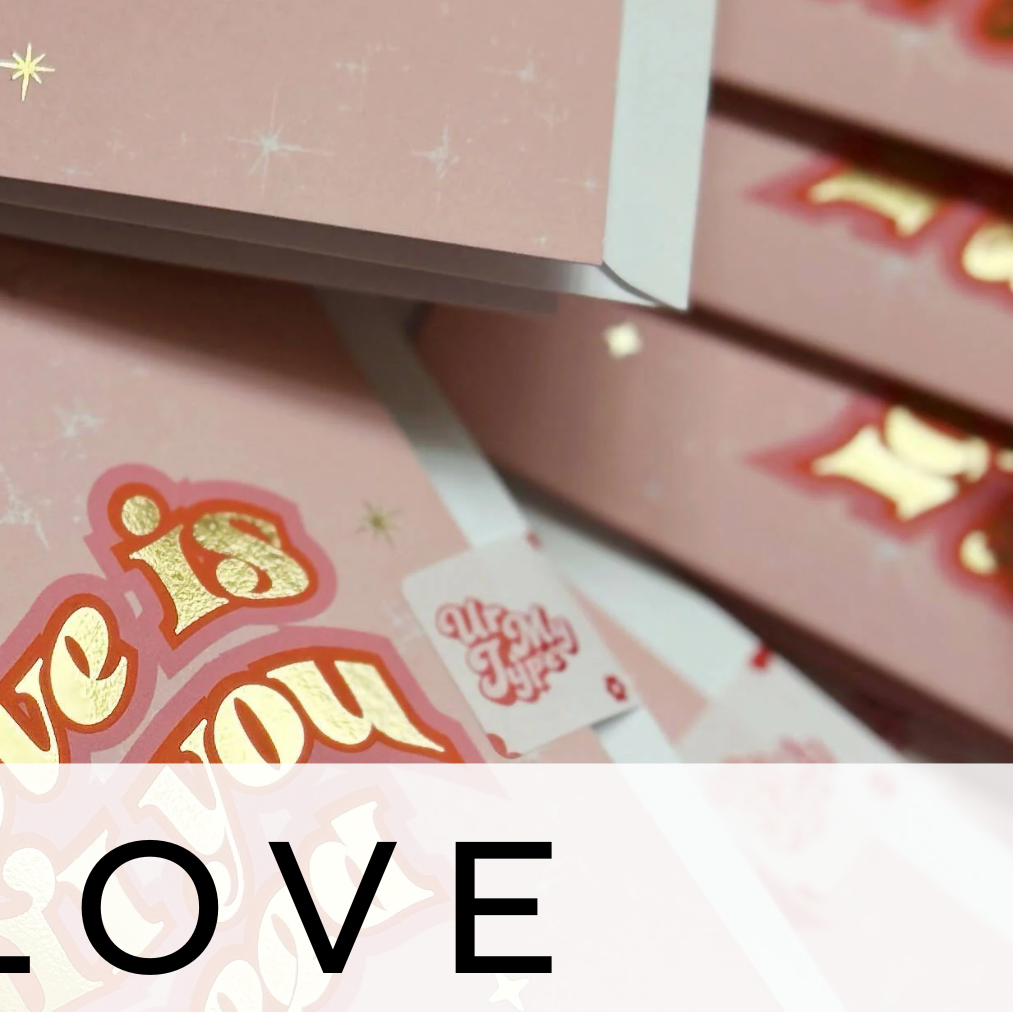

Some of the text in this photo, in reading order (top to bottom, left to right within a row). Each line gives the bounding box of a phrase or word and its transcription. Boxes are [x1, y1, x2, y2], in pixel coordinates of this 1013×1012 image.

[121, 494, 310, 635] is
[435, 596, 579, 660] Ur My
[465, 635, 568, 706] Type
[138, 660, 445, 909] you
